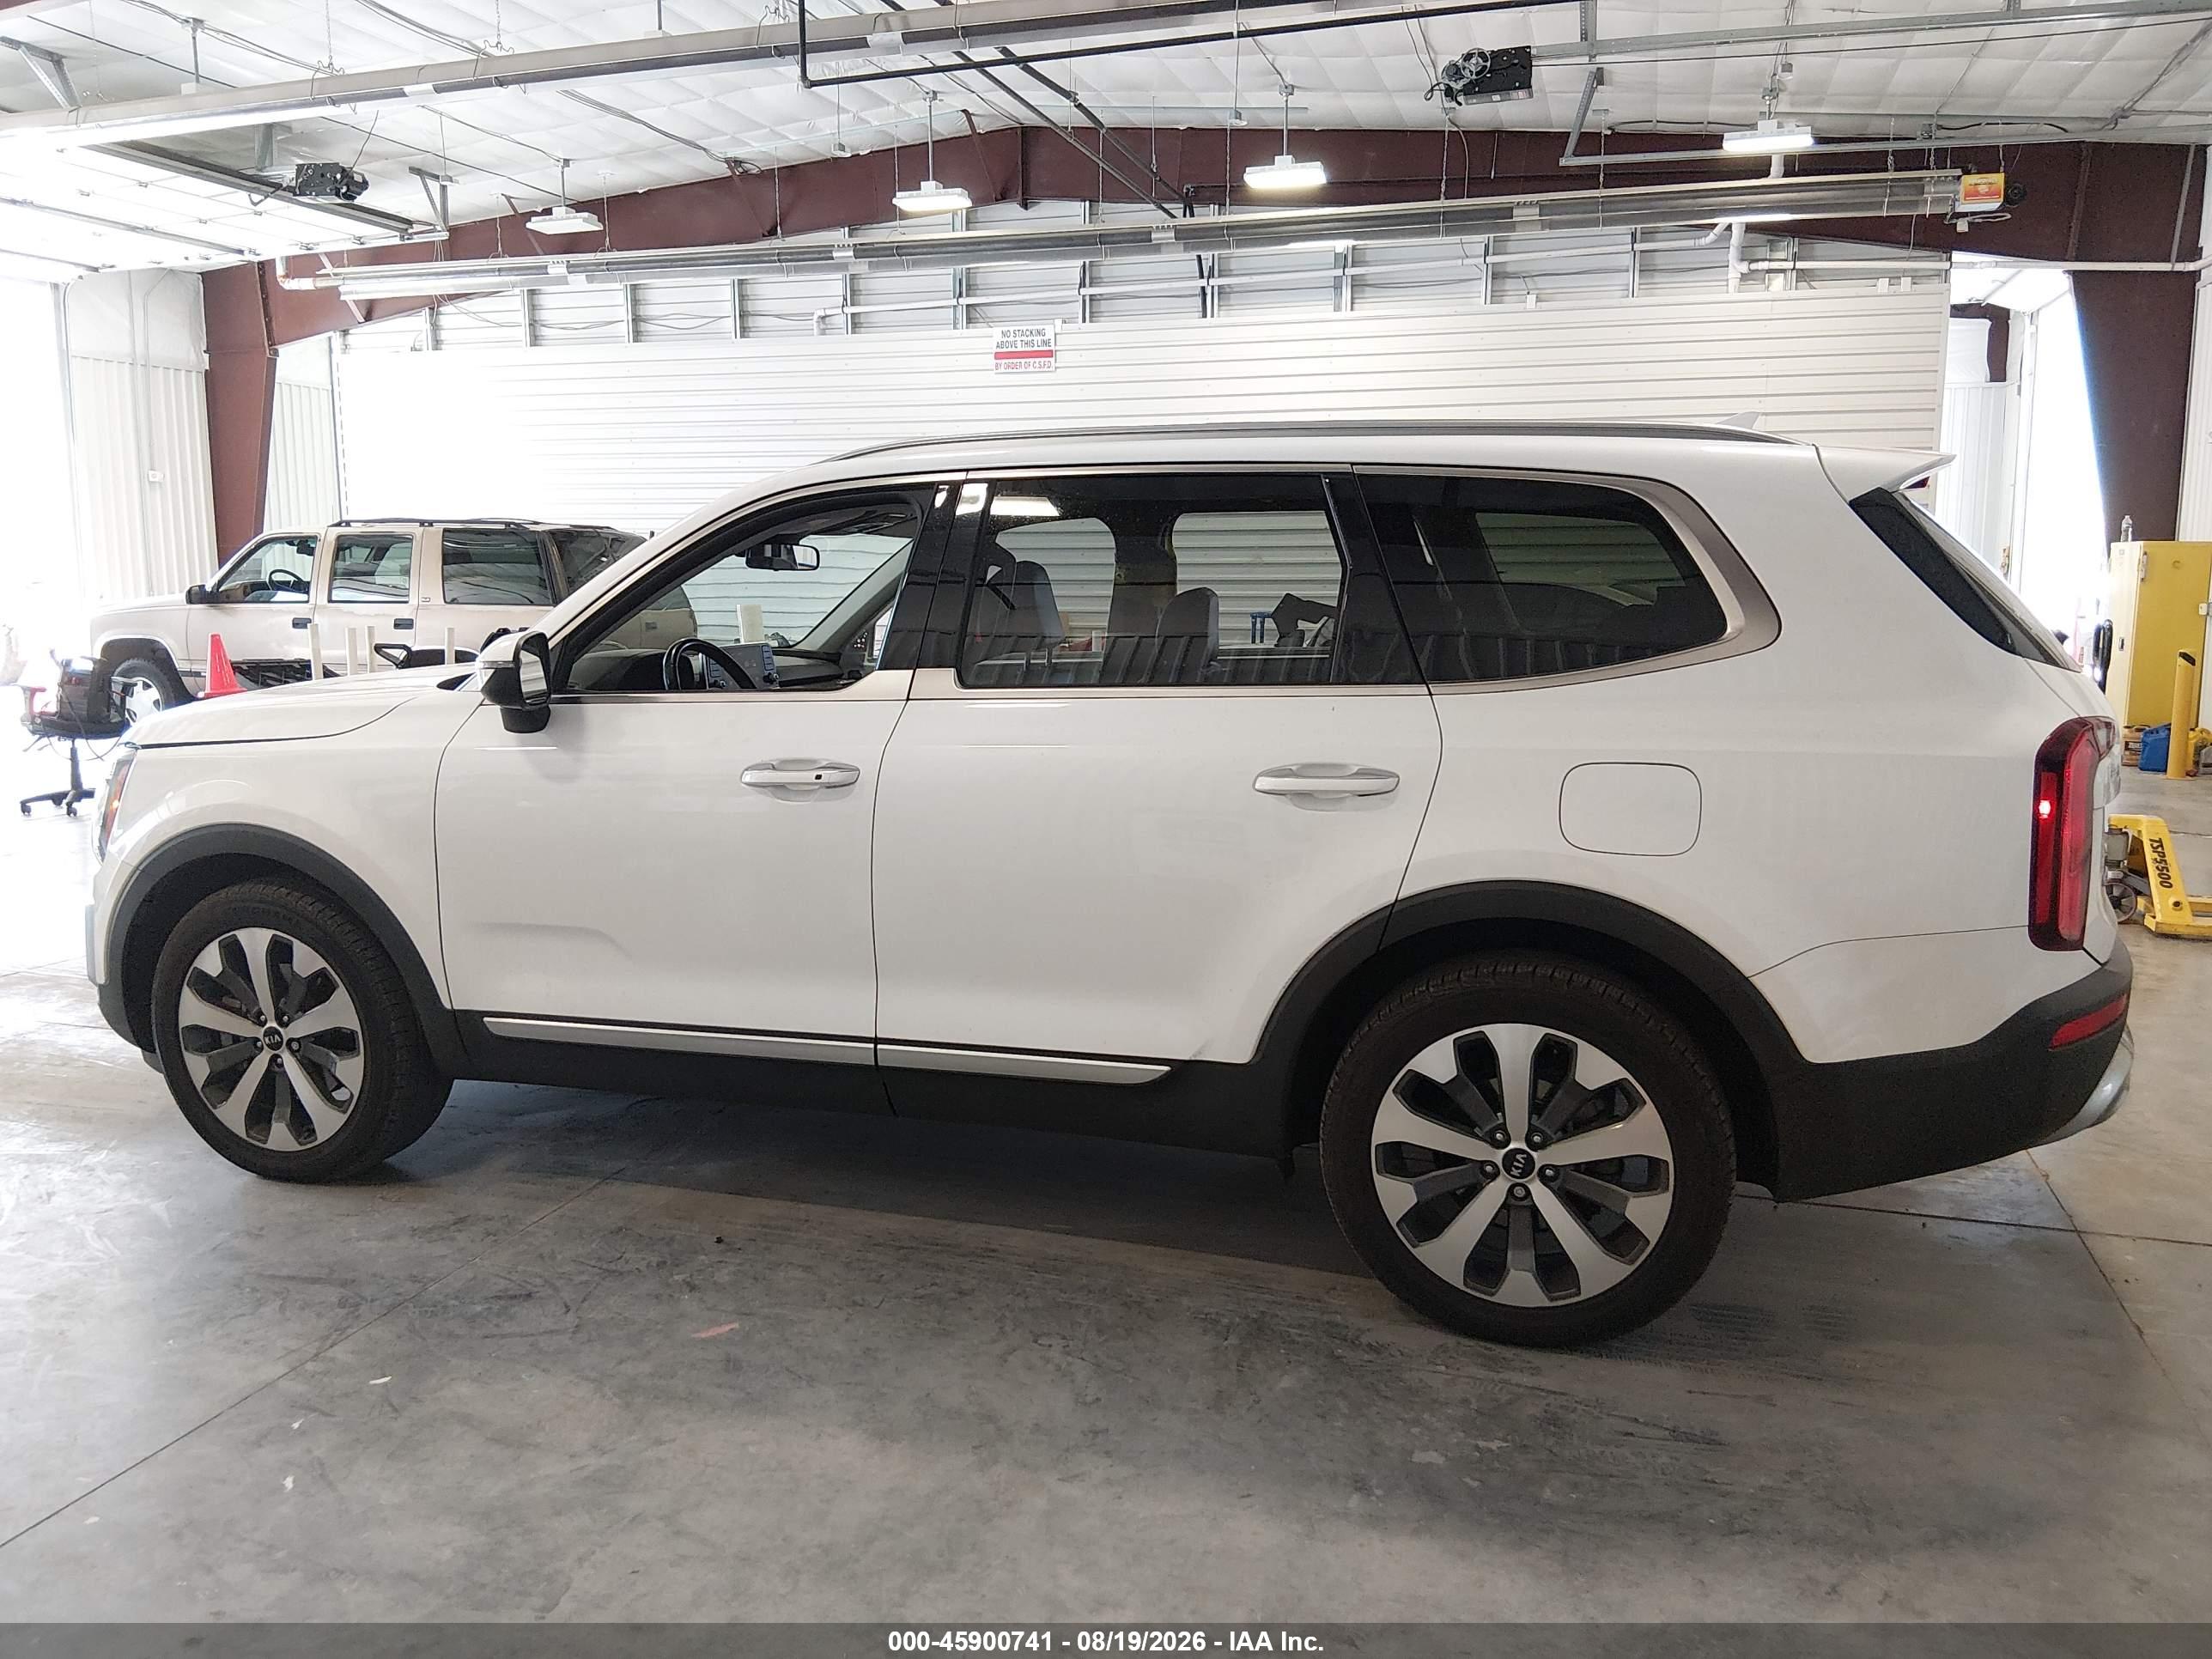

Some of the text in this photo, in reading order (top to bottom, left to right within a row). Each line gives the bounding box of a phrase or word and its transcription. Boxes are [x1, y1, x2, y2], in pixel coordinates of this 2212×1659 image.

[1001, 328, 1046, 338] NO STACKING
[996, 338, 1052, 349] ABOVE THIS LINE
[994, 362, 1003, 371] BY
[1003, 362, 1023, 370] ORDER
[2148, 837, 2173, 889] TSP5500
[264, 1034, 282, 1045] KIA
[1510, 1153, 1528, 1177] KIA
